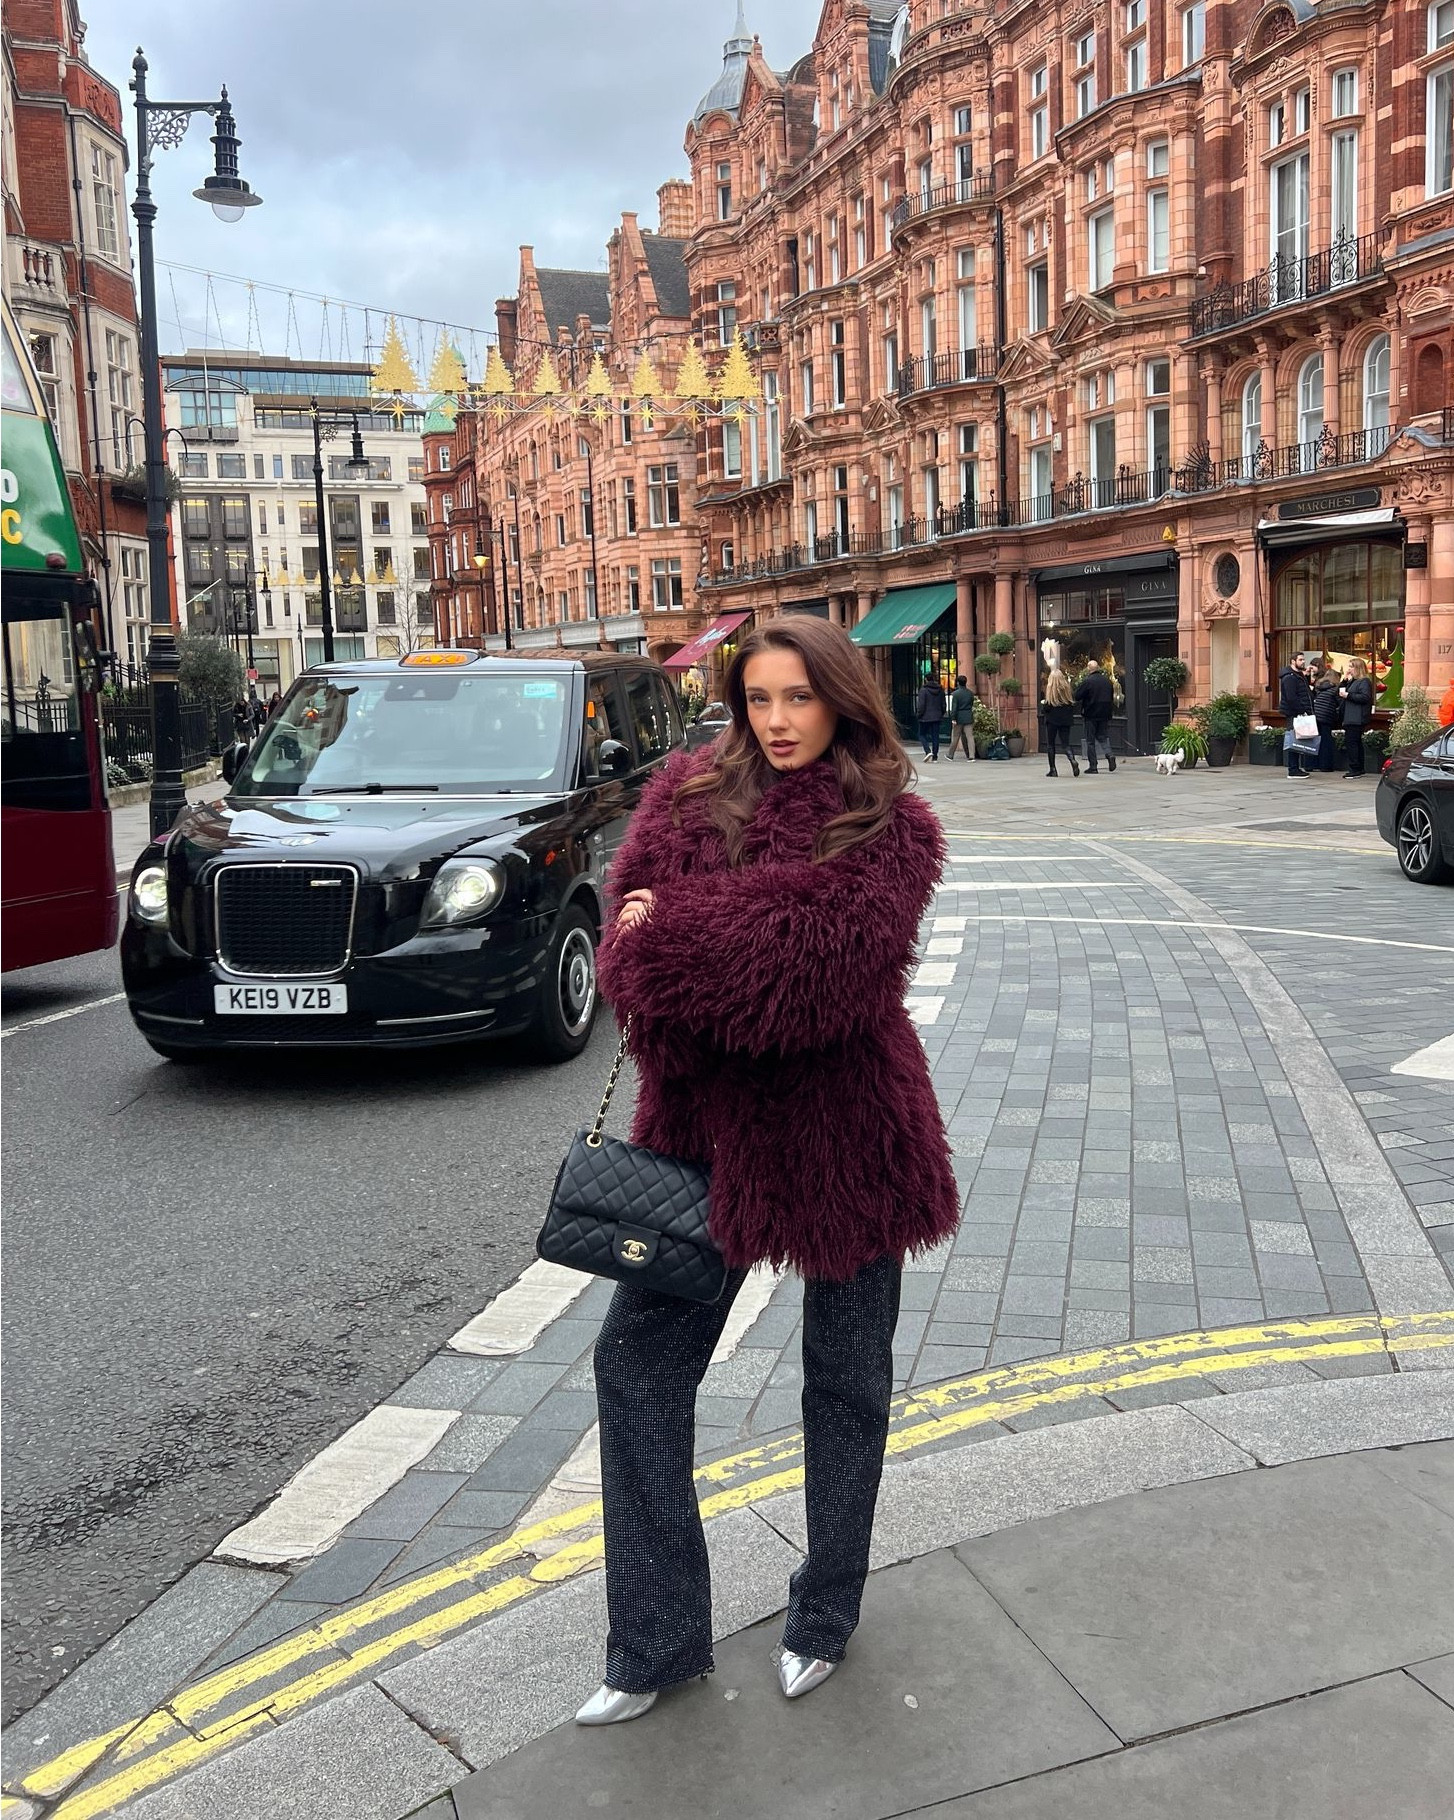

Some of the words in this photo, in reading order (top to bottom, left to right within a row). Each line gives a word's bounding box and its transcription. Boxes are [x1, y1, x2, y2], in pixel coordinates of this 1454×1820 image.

[1297, 495, 1355, 512] MARCHESI
[1083, 564, 1101, 574] GINA
[1141, 581, 1166, 592] GINA
[1438, 644, 1452, 654] 117
[409, 654, 467, 664] TAXI
[229, 988, 279, 1009] KE19
[286, 988, 331, 1009] VZB
